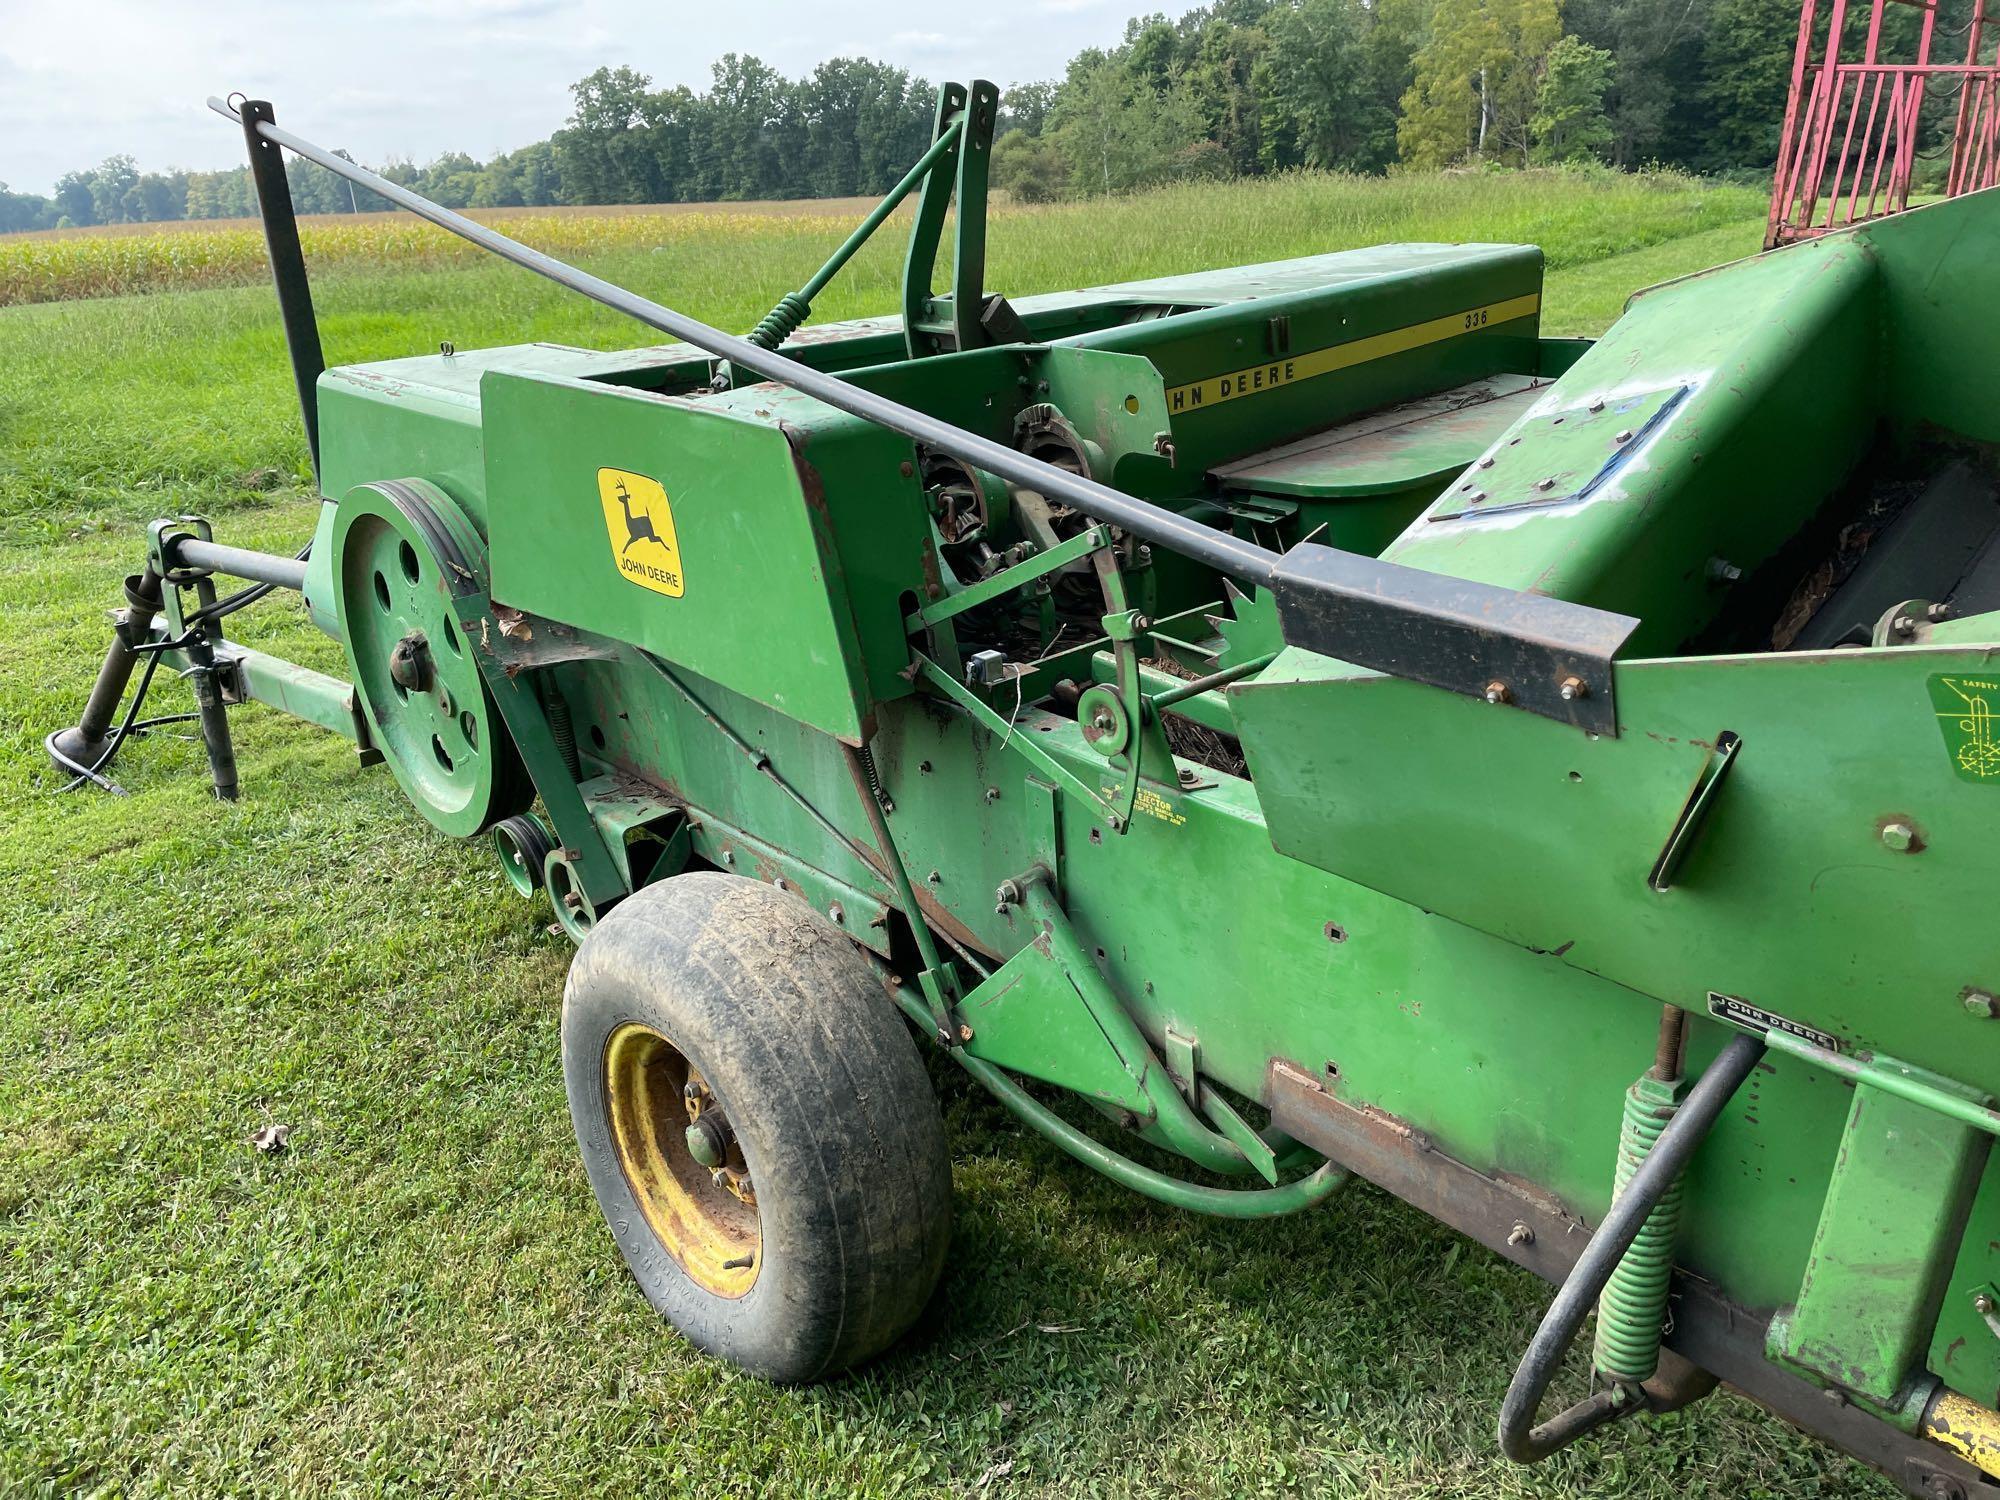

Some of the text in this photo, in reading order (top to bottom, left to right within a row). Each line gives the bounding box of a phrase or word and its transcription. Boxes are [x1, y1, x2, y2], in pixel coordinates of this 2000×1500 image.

[1465, 310, 1488, 329] 336
[1173, 361, 1294, 411] HN DEERE
[621, 558, 679, 588] JOHN DEERE
[1962, 680, 1998, 690] SAFETY
[1138, 793, 1172, 811] EJECTOR
[1718, 998, 1828, 1043] JOHN DEERE
